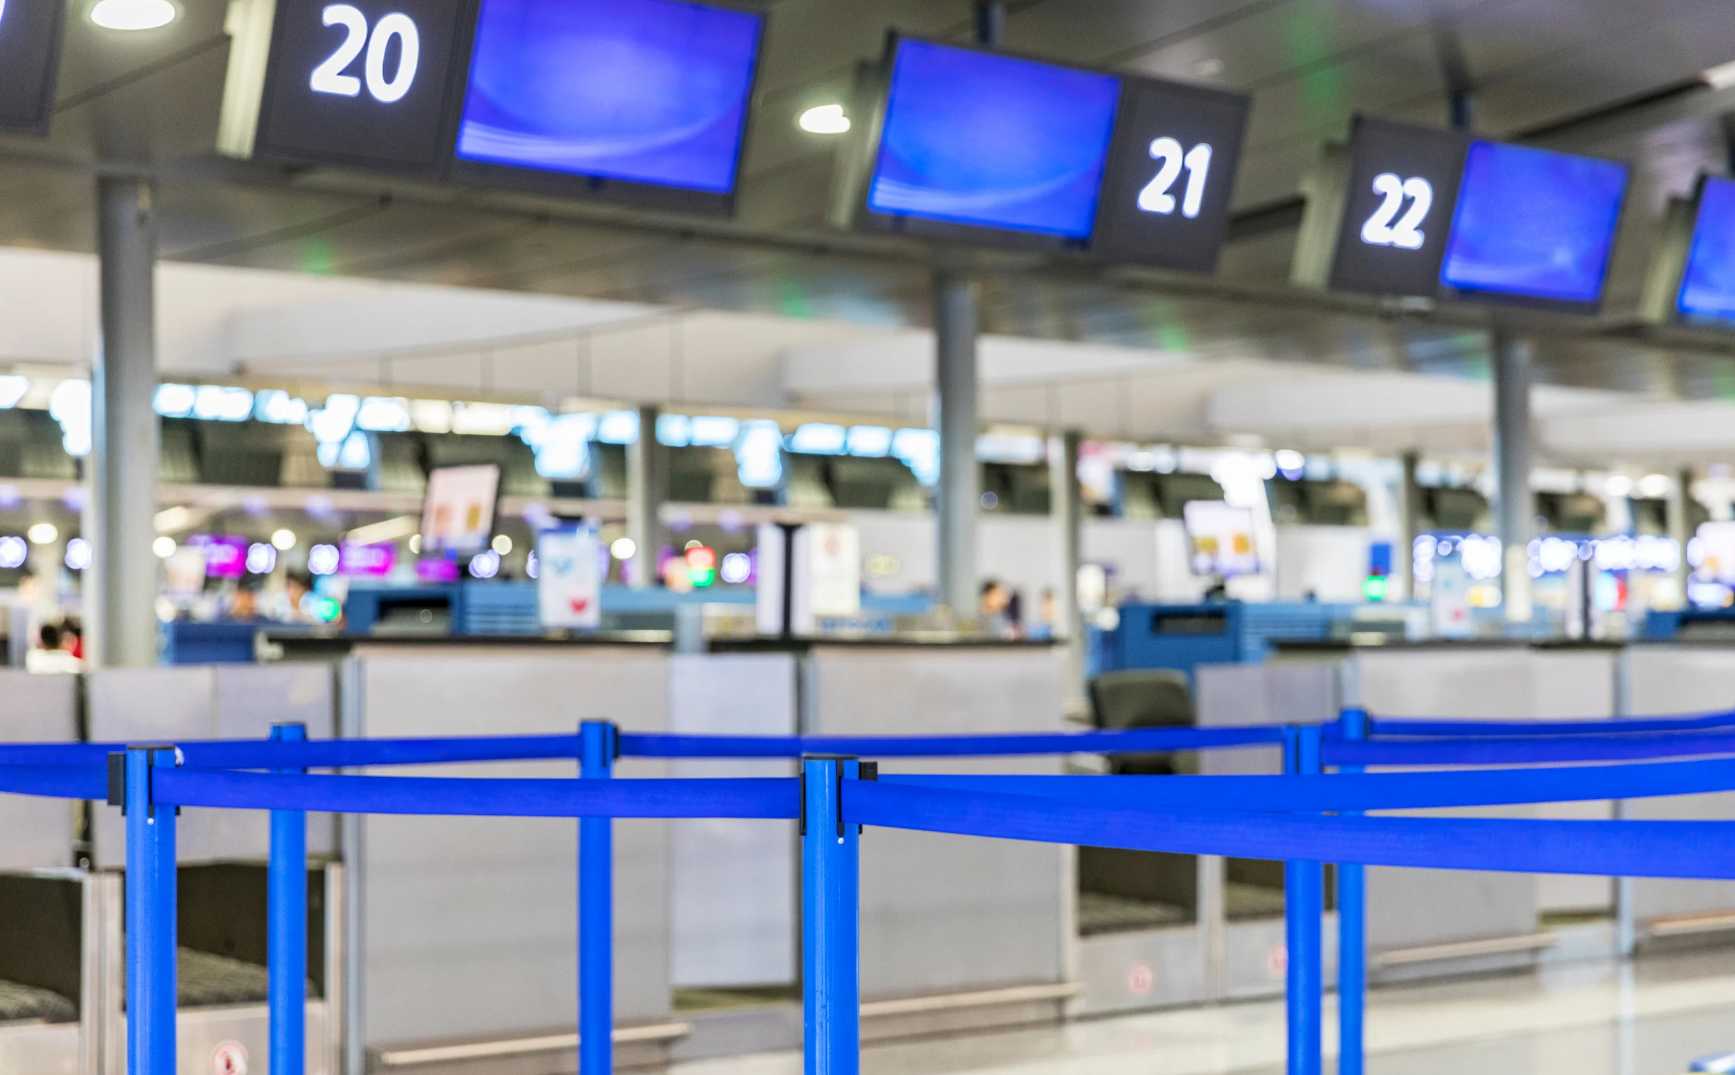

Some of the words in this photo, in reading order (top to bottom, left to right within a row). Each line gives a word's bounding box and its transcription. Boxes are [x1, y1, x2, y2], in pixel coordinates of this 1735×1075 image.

[309, 3, 420, 104] 20
[1137, 136, 1213, 217] 21
[1360, 172, 1433, 250] 22
